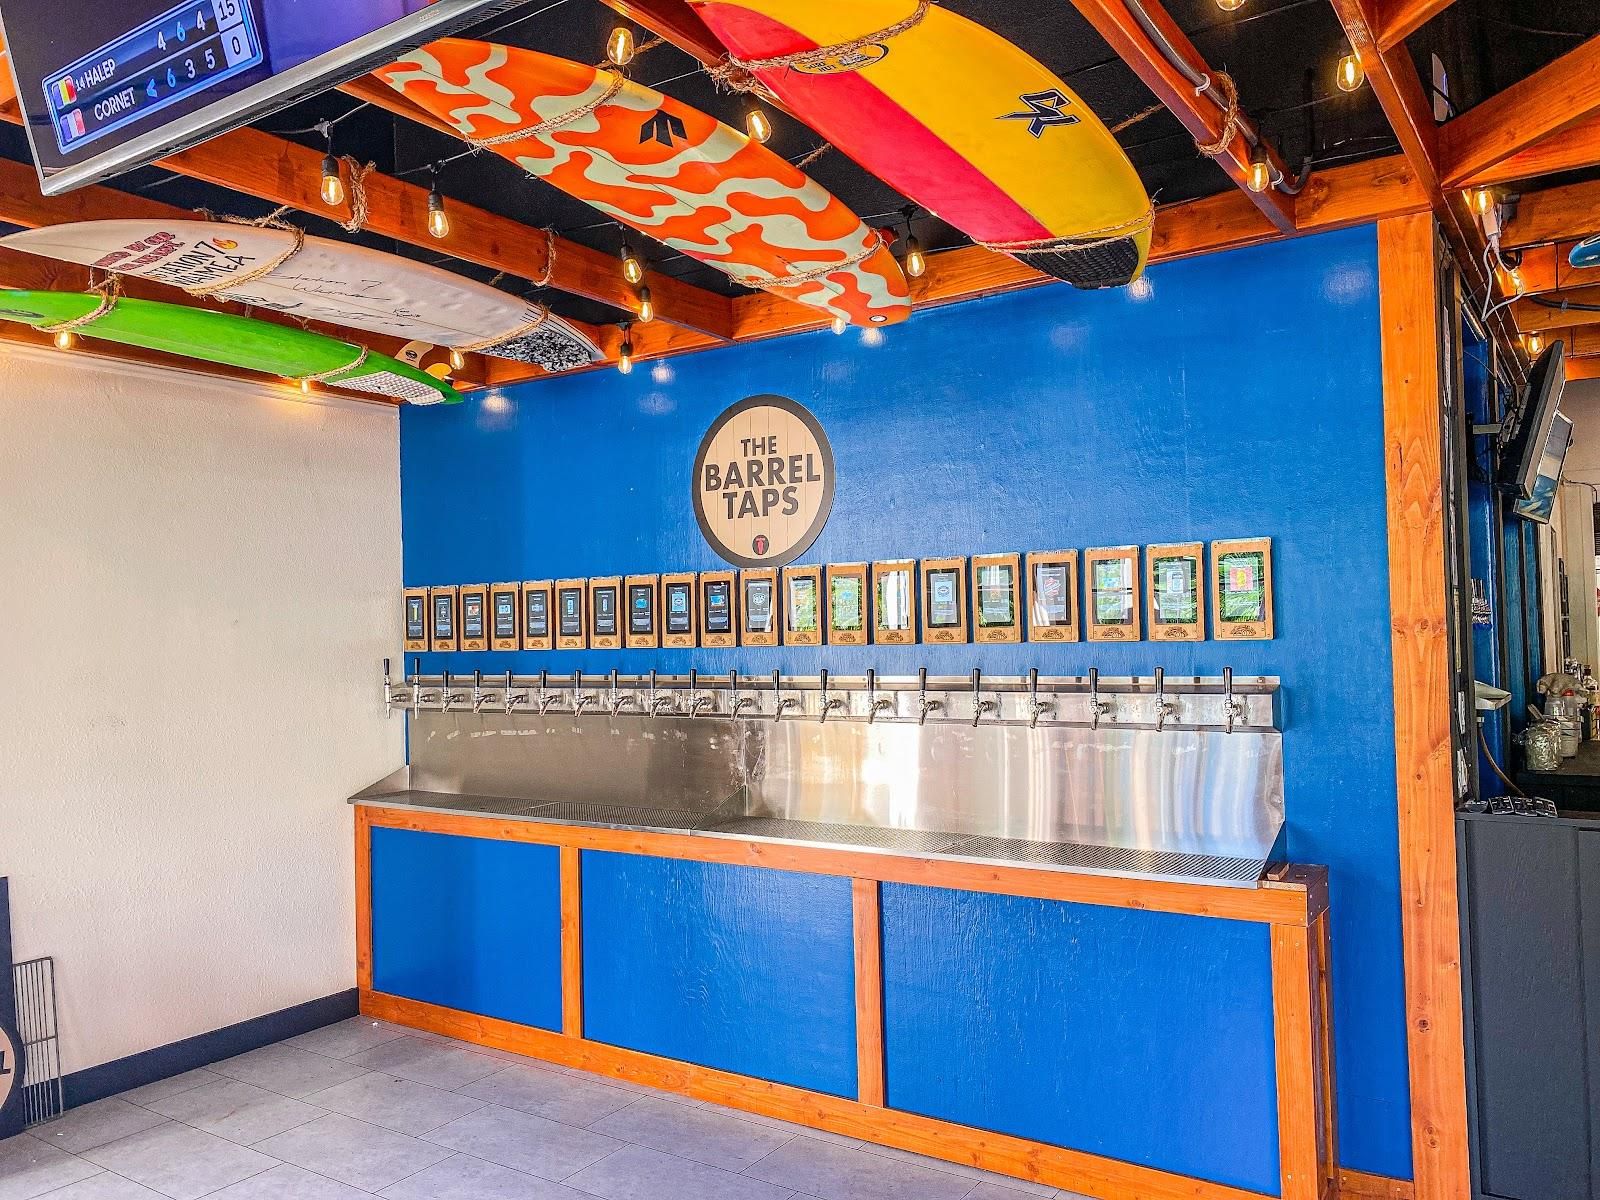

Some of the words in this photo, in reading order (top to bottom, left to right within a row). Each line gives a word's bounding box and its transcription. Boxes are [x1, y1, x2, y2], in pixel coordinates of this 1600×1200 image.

[84, 58, 116, 88] HALEP
[157, 31, 167, 51] 4
[176, 21, 186, 42] 6
[196, 10, 206, 31] 4
[218, 0, 235, 21] 15
[94, 87, 136, 121] CORNET
[166, 68, 177, 88] 6
[184, 59, 196, 79] 3
[204, 48, 216, 70] 5
[231, 36, 241, 55] 0
[143, 250, 216, 280] STATION
[193, 240, 226, 255] 7
[740, 435, 777, 457] THE
[705, 453, 821, 492] BARREL
[722, 485, 799, 519] TAPS
